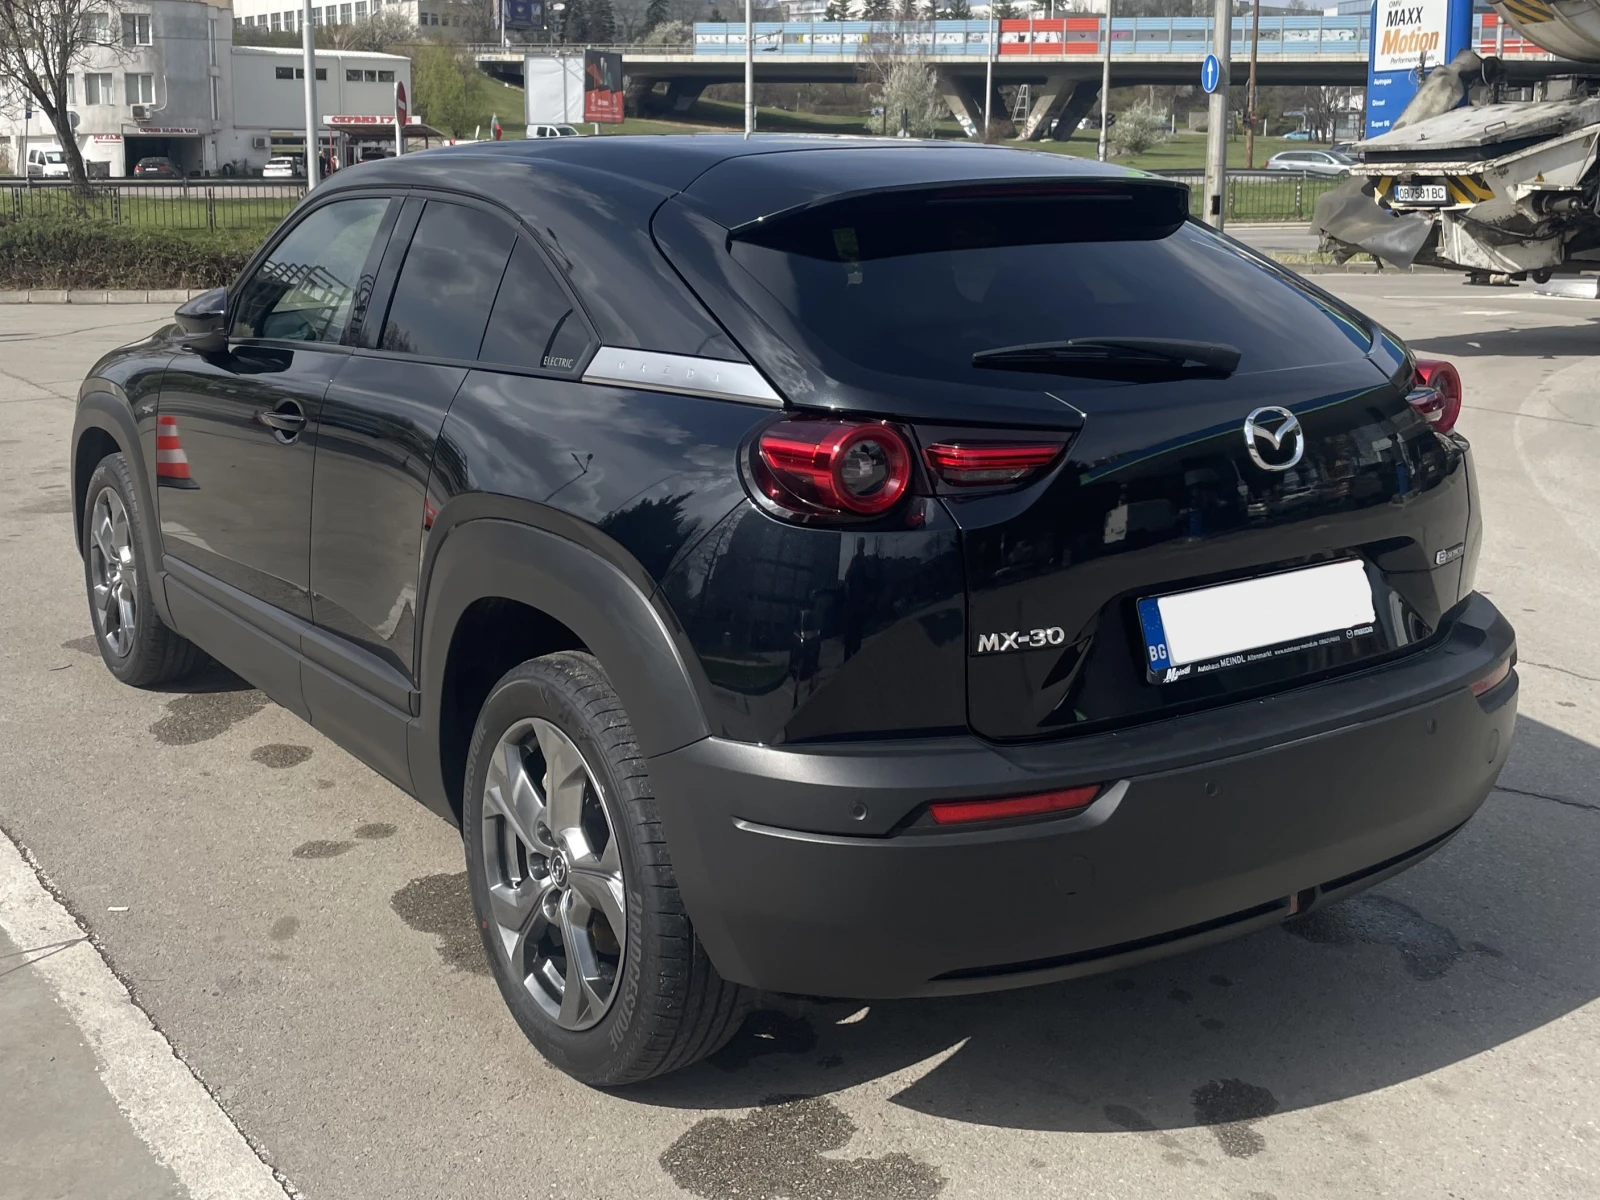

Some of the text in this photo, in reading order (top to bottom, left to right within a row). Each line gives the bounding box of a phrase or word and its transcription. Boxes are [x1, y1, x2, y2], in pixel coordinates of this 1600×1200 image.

[1386, 6, 1424, 27] MAXX
[1381, 26, 1440, 55] Motion
[331, 116, 378, 124] СЕРВИЗ
[543, 356, 574, 369] ELECTRIC
[977, 626, 1065, 653] MX-30
[1148, 643, 1168, 663] BG
[1197, 662, 1221, 673] Autohaus
[1220, 654, 1247, 668] MEINDL
[1247, 650, 1273, 662] Altenmarkt
